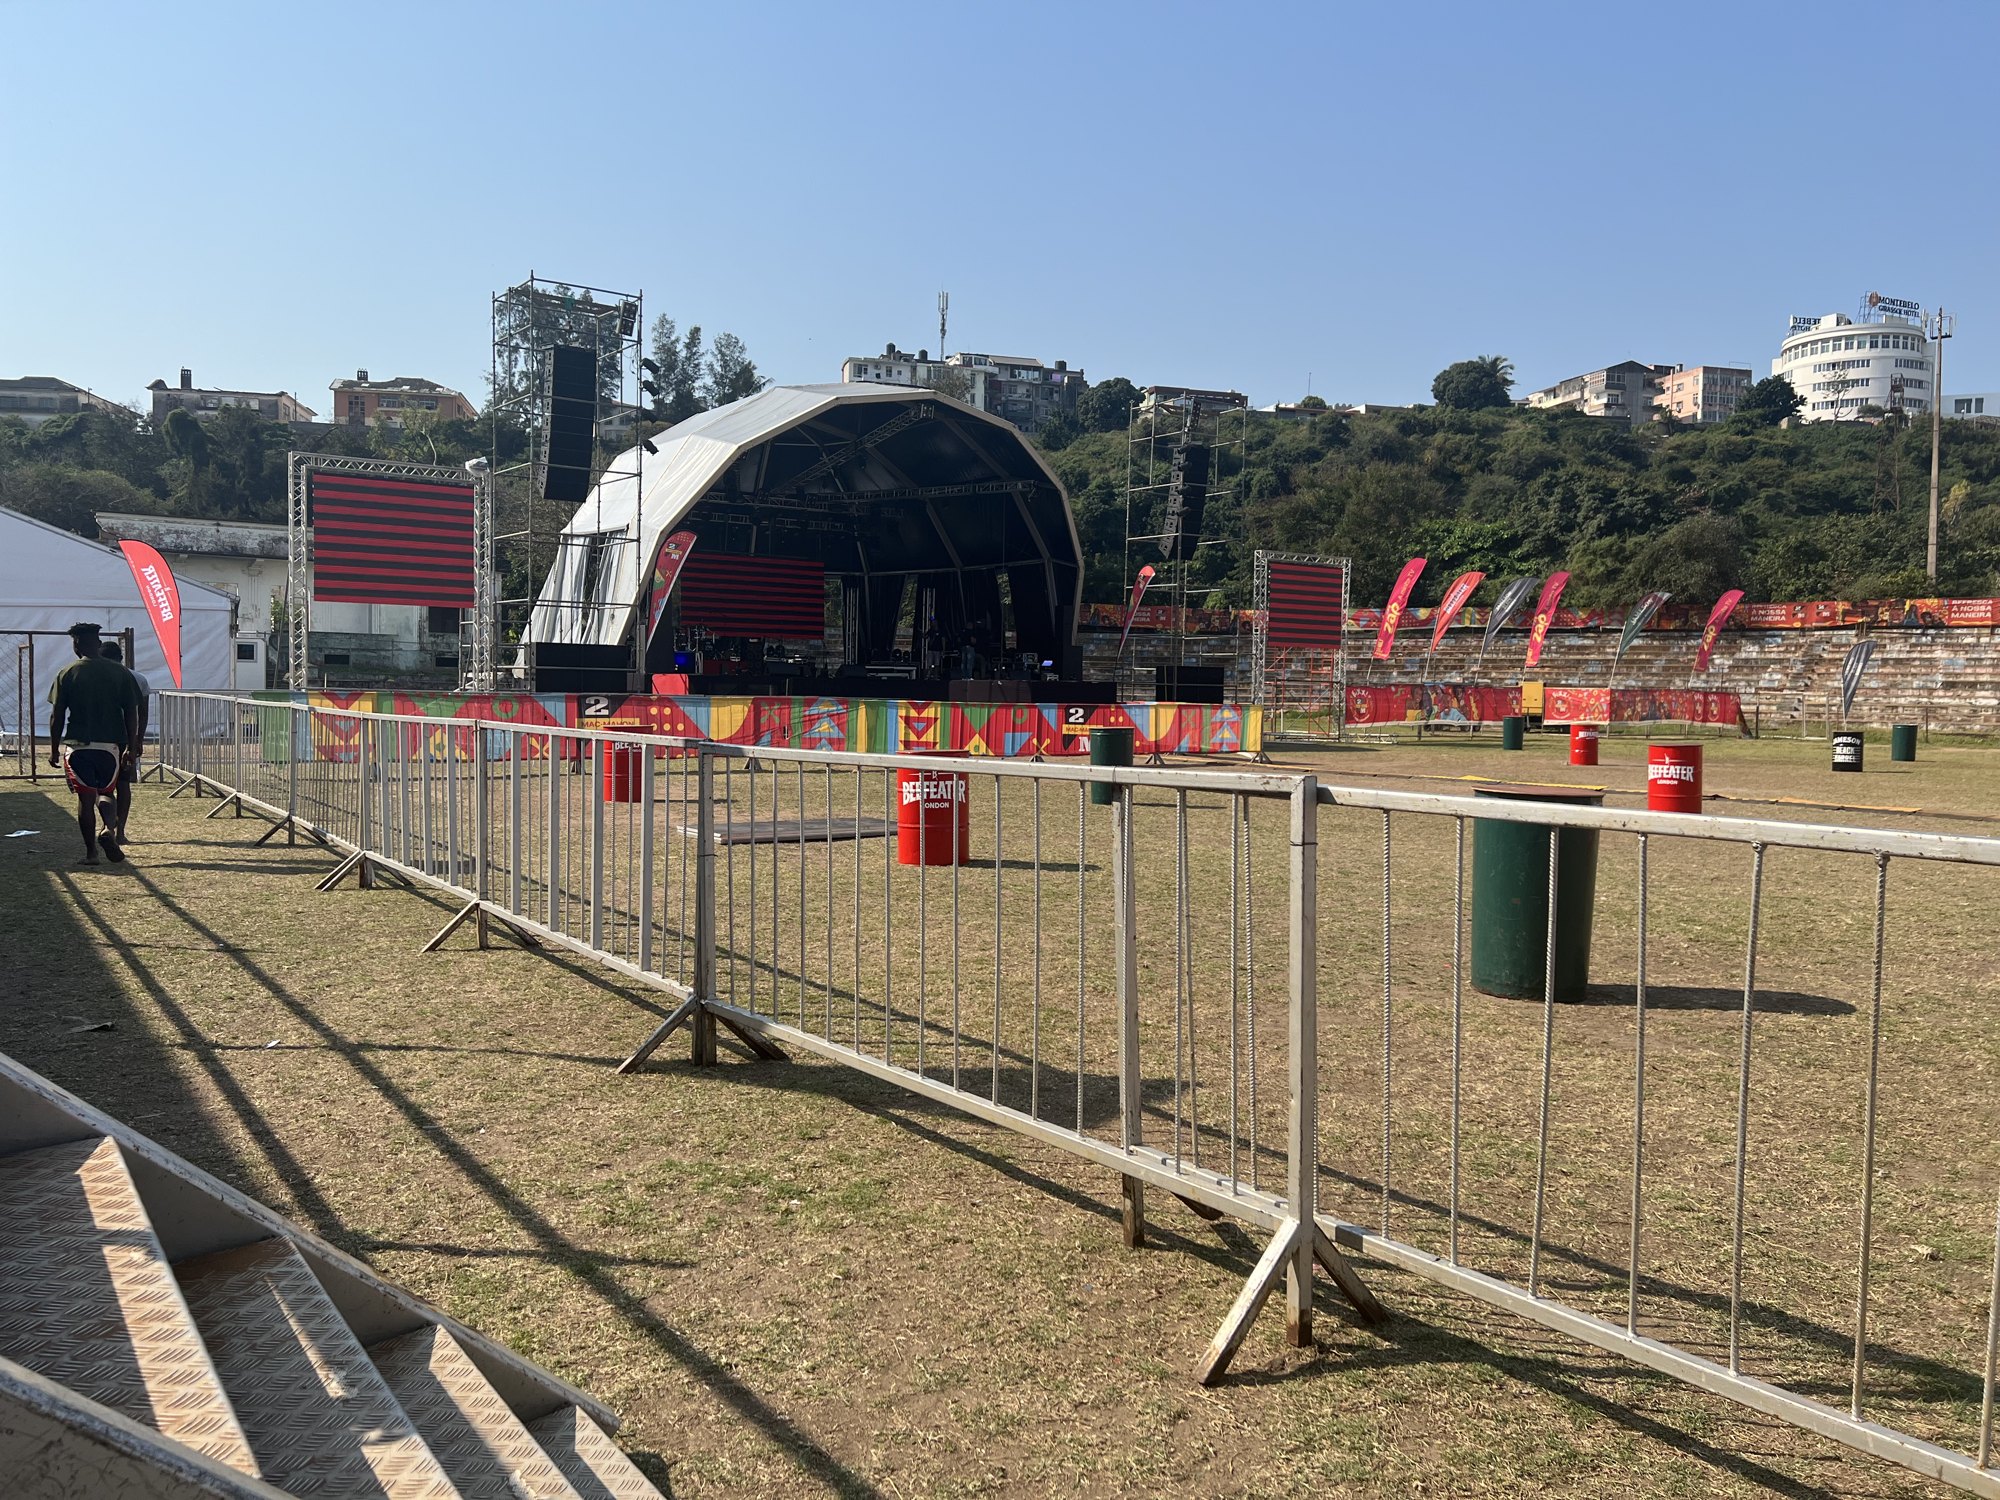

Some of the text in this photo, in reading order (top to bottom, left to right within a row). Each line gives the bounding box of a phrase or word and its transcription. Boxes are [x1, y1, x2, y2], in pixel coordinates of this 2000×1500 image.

[1878, 295, 1920, 310] MONTEBELO
[1903, 309, 1920, 318] HOTEL
[1384, 602, 1402, 634] zap
[1533, 613, 1549, 643] zap
[585, 696, 609, 716] 2
[1069, 707, 1085, 723] 2
[902, 780, 966, 806] BEEFEATR
